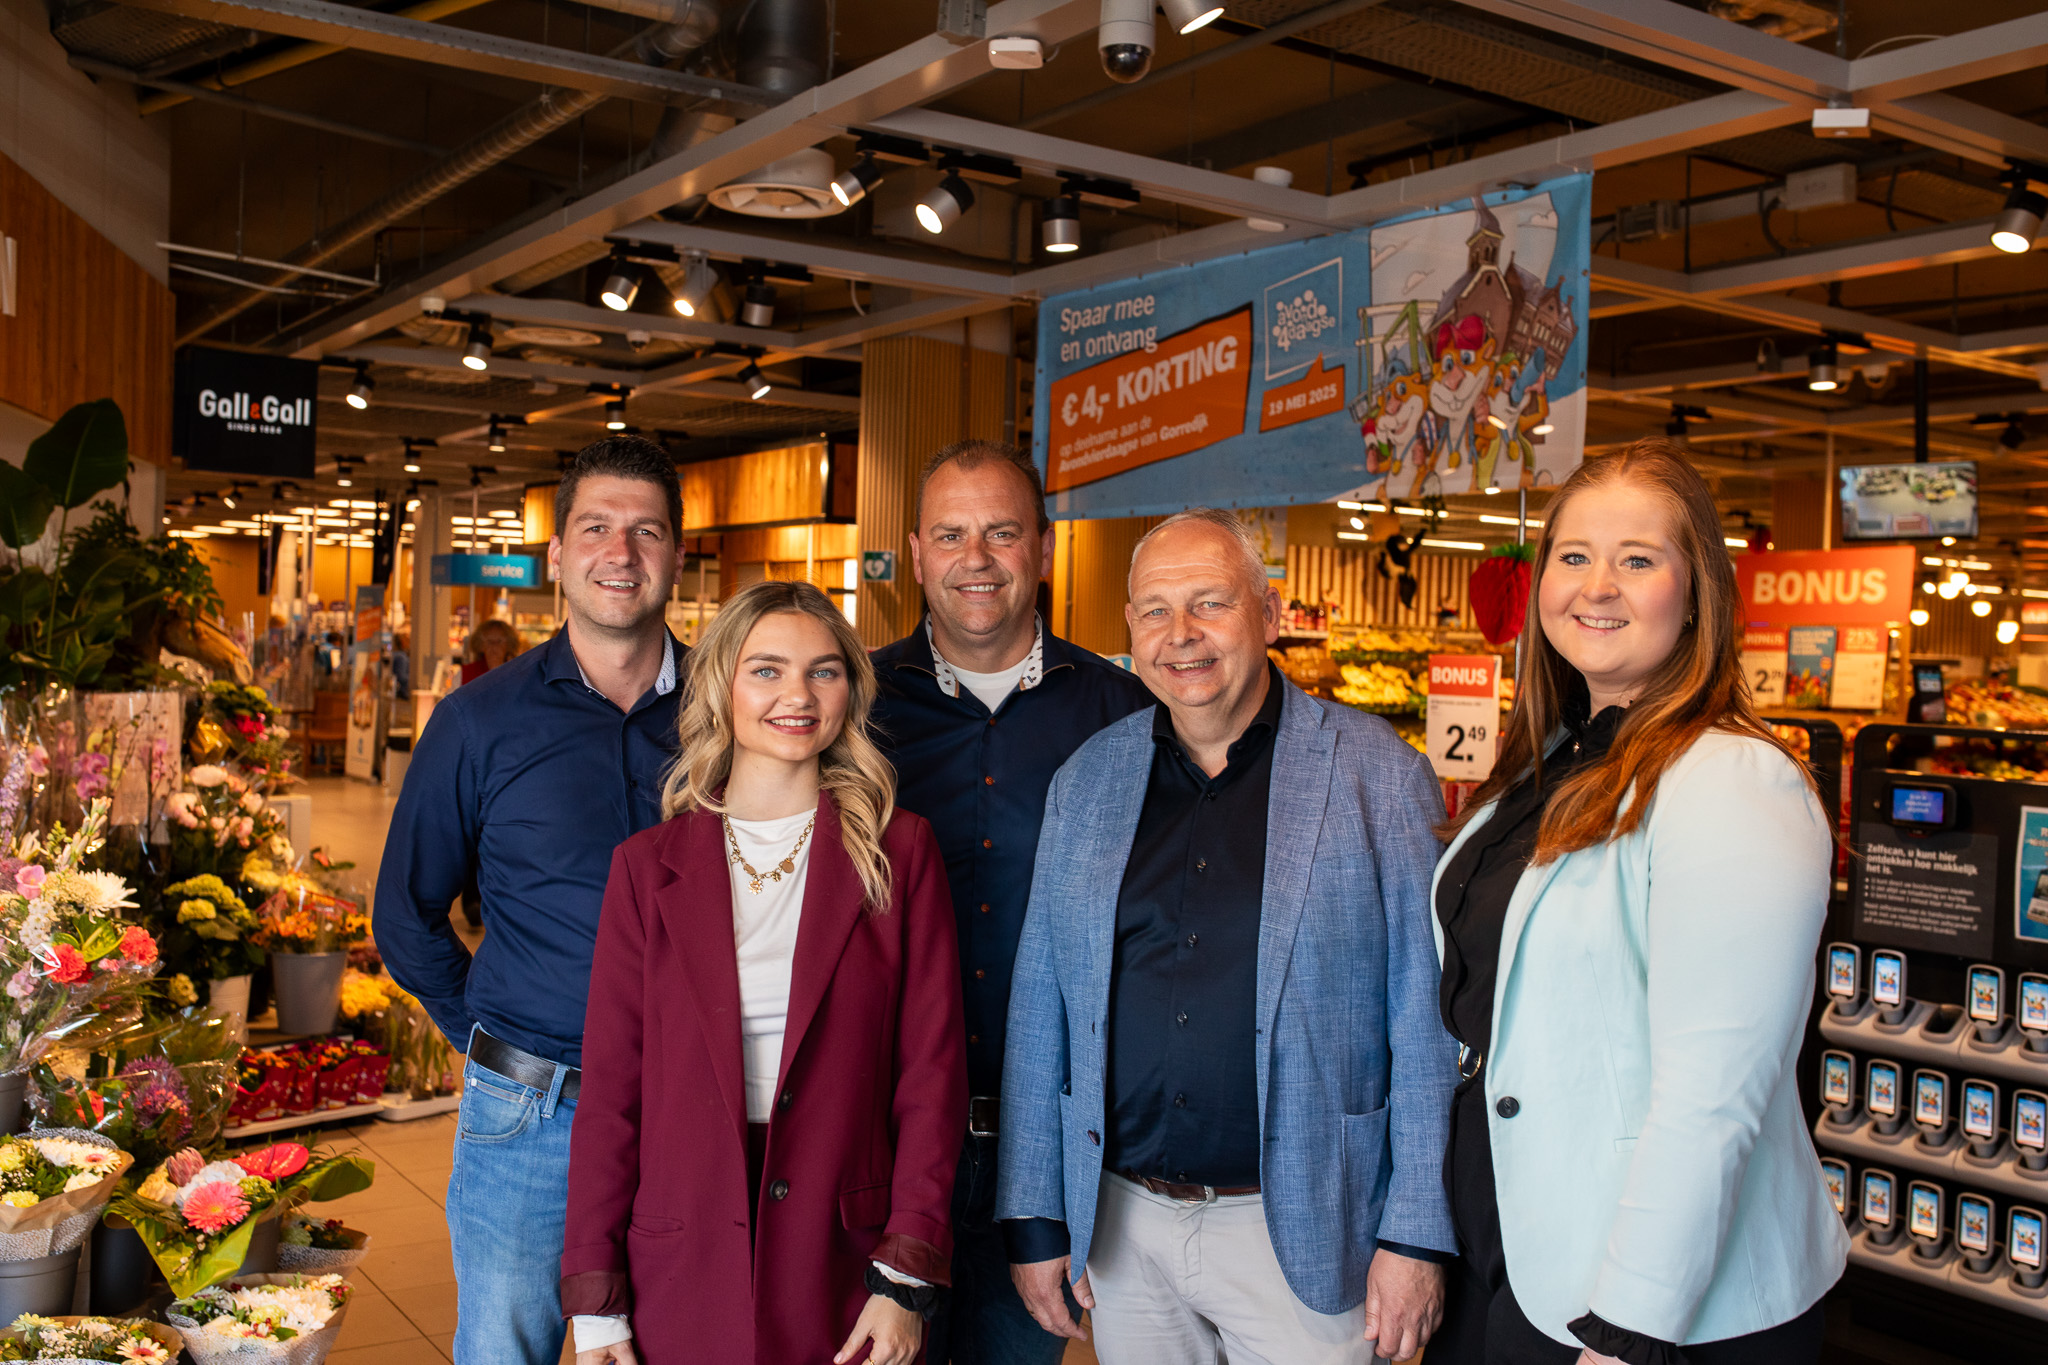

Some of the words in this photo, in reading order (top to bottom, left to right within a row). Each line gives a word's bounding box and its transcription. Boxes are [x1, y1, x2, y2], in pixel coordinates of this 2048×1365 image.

[1060, 303, 1112, 335] Spaar
[1114, 295, 1155, 321] mee
[1060, 341, 1081, 362] en
[1085, 326, 1159, 358] ontvang
[1061, 392, 1080, 428] €
[1117, 335, 1239, 409] KORTING
[1268, 400, 1284, 416] 19
[1285, 393, 1307, 412] MEI
[1308, 383, 1338, 405] 2025
[1140, 415, 1153, 430] de
[1140, 431, 1158, 447] van
[481, 563, 525, 579] service
[1753, 567, 1888, 605] BONUS
[1431, 666, 1488, 687] BONUS
[1867, 843, 1906, 858] Zelfscan,
[1907, 849, 1914, 857] u
[1916, 848, 1937, 860] kunt
[1938, 851, 1958, 862] hier
[1866, 854, 1913, 868] ontdekken
[1914, 858, 1932, 870] hoe
[1933, 862, 1979, 877] makkelijk
[1866, 862, 1881, 873] het
